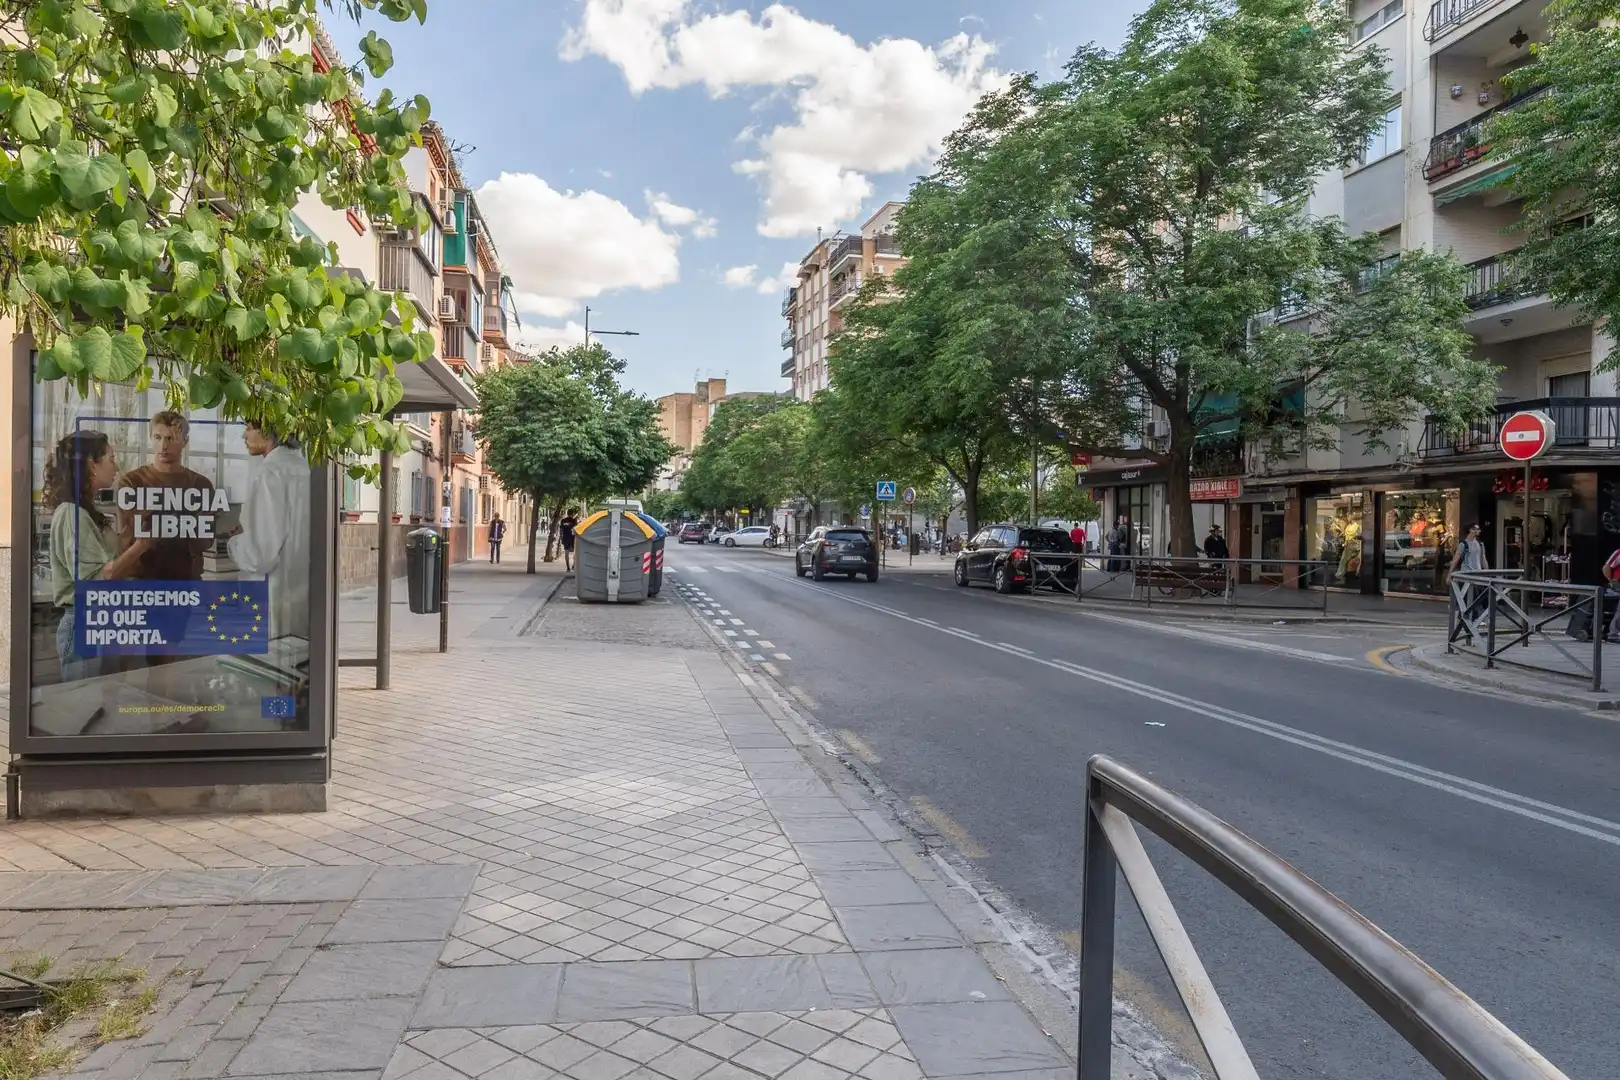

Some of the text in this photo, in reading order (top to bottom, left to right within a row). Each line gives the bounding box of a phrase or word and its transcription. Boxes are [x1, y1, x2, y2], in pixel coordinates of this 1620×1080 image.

[117, 487, 230, 512] CIENCIA
[134, 514, 214, 538] LIBRE
[86, 590, 200, 606] PROTEGEMOS
[86, 610, 147, 627] LO QUE
[86, 629, 167, 645] IMPORTA.
[119, 704, 225, 715] europa.eu/es/democracia
